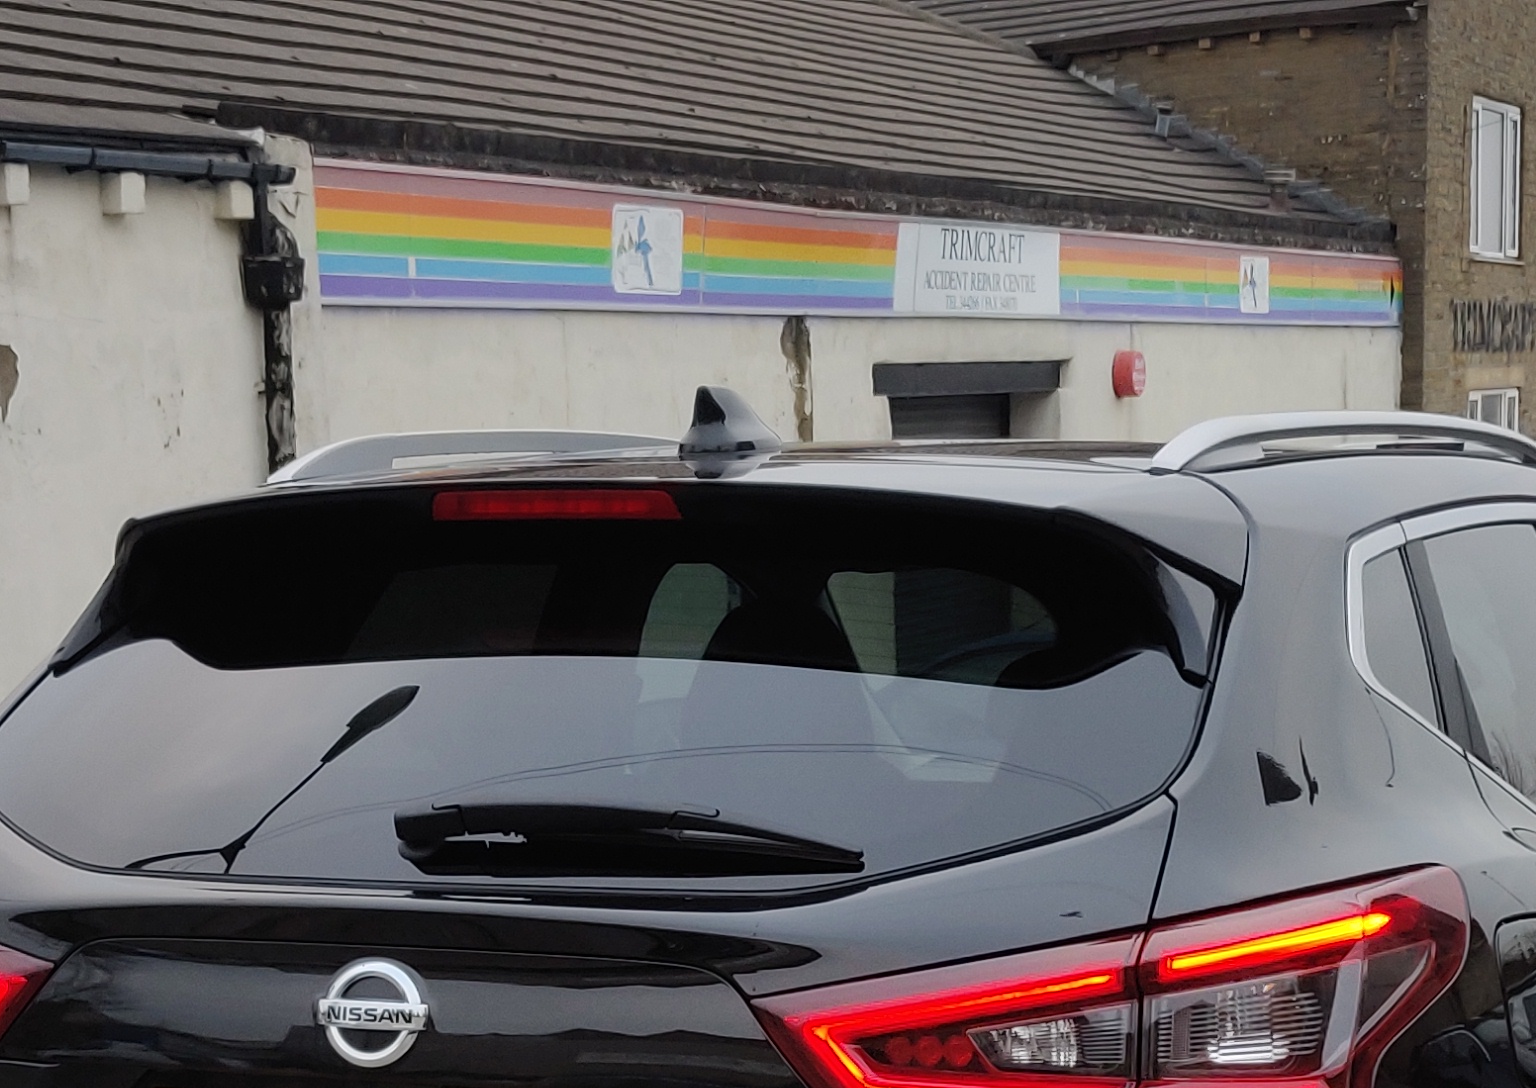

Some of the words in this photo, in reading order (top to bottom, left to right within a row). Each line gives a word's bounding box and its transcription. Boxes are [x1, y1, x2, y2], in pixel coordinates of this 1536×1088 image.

[941, 227, 1025, 264] TRIMCRAFT
[924, 269, 968, 290] ACCIDENT
[970, 271, 1002, 292] REPAIR
[1003, 274, 1036, 293] CENTRE
[327, 1004, 412, 1024] NISSAN
